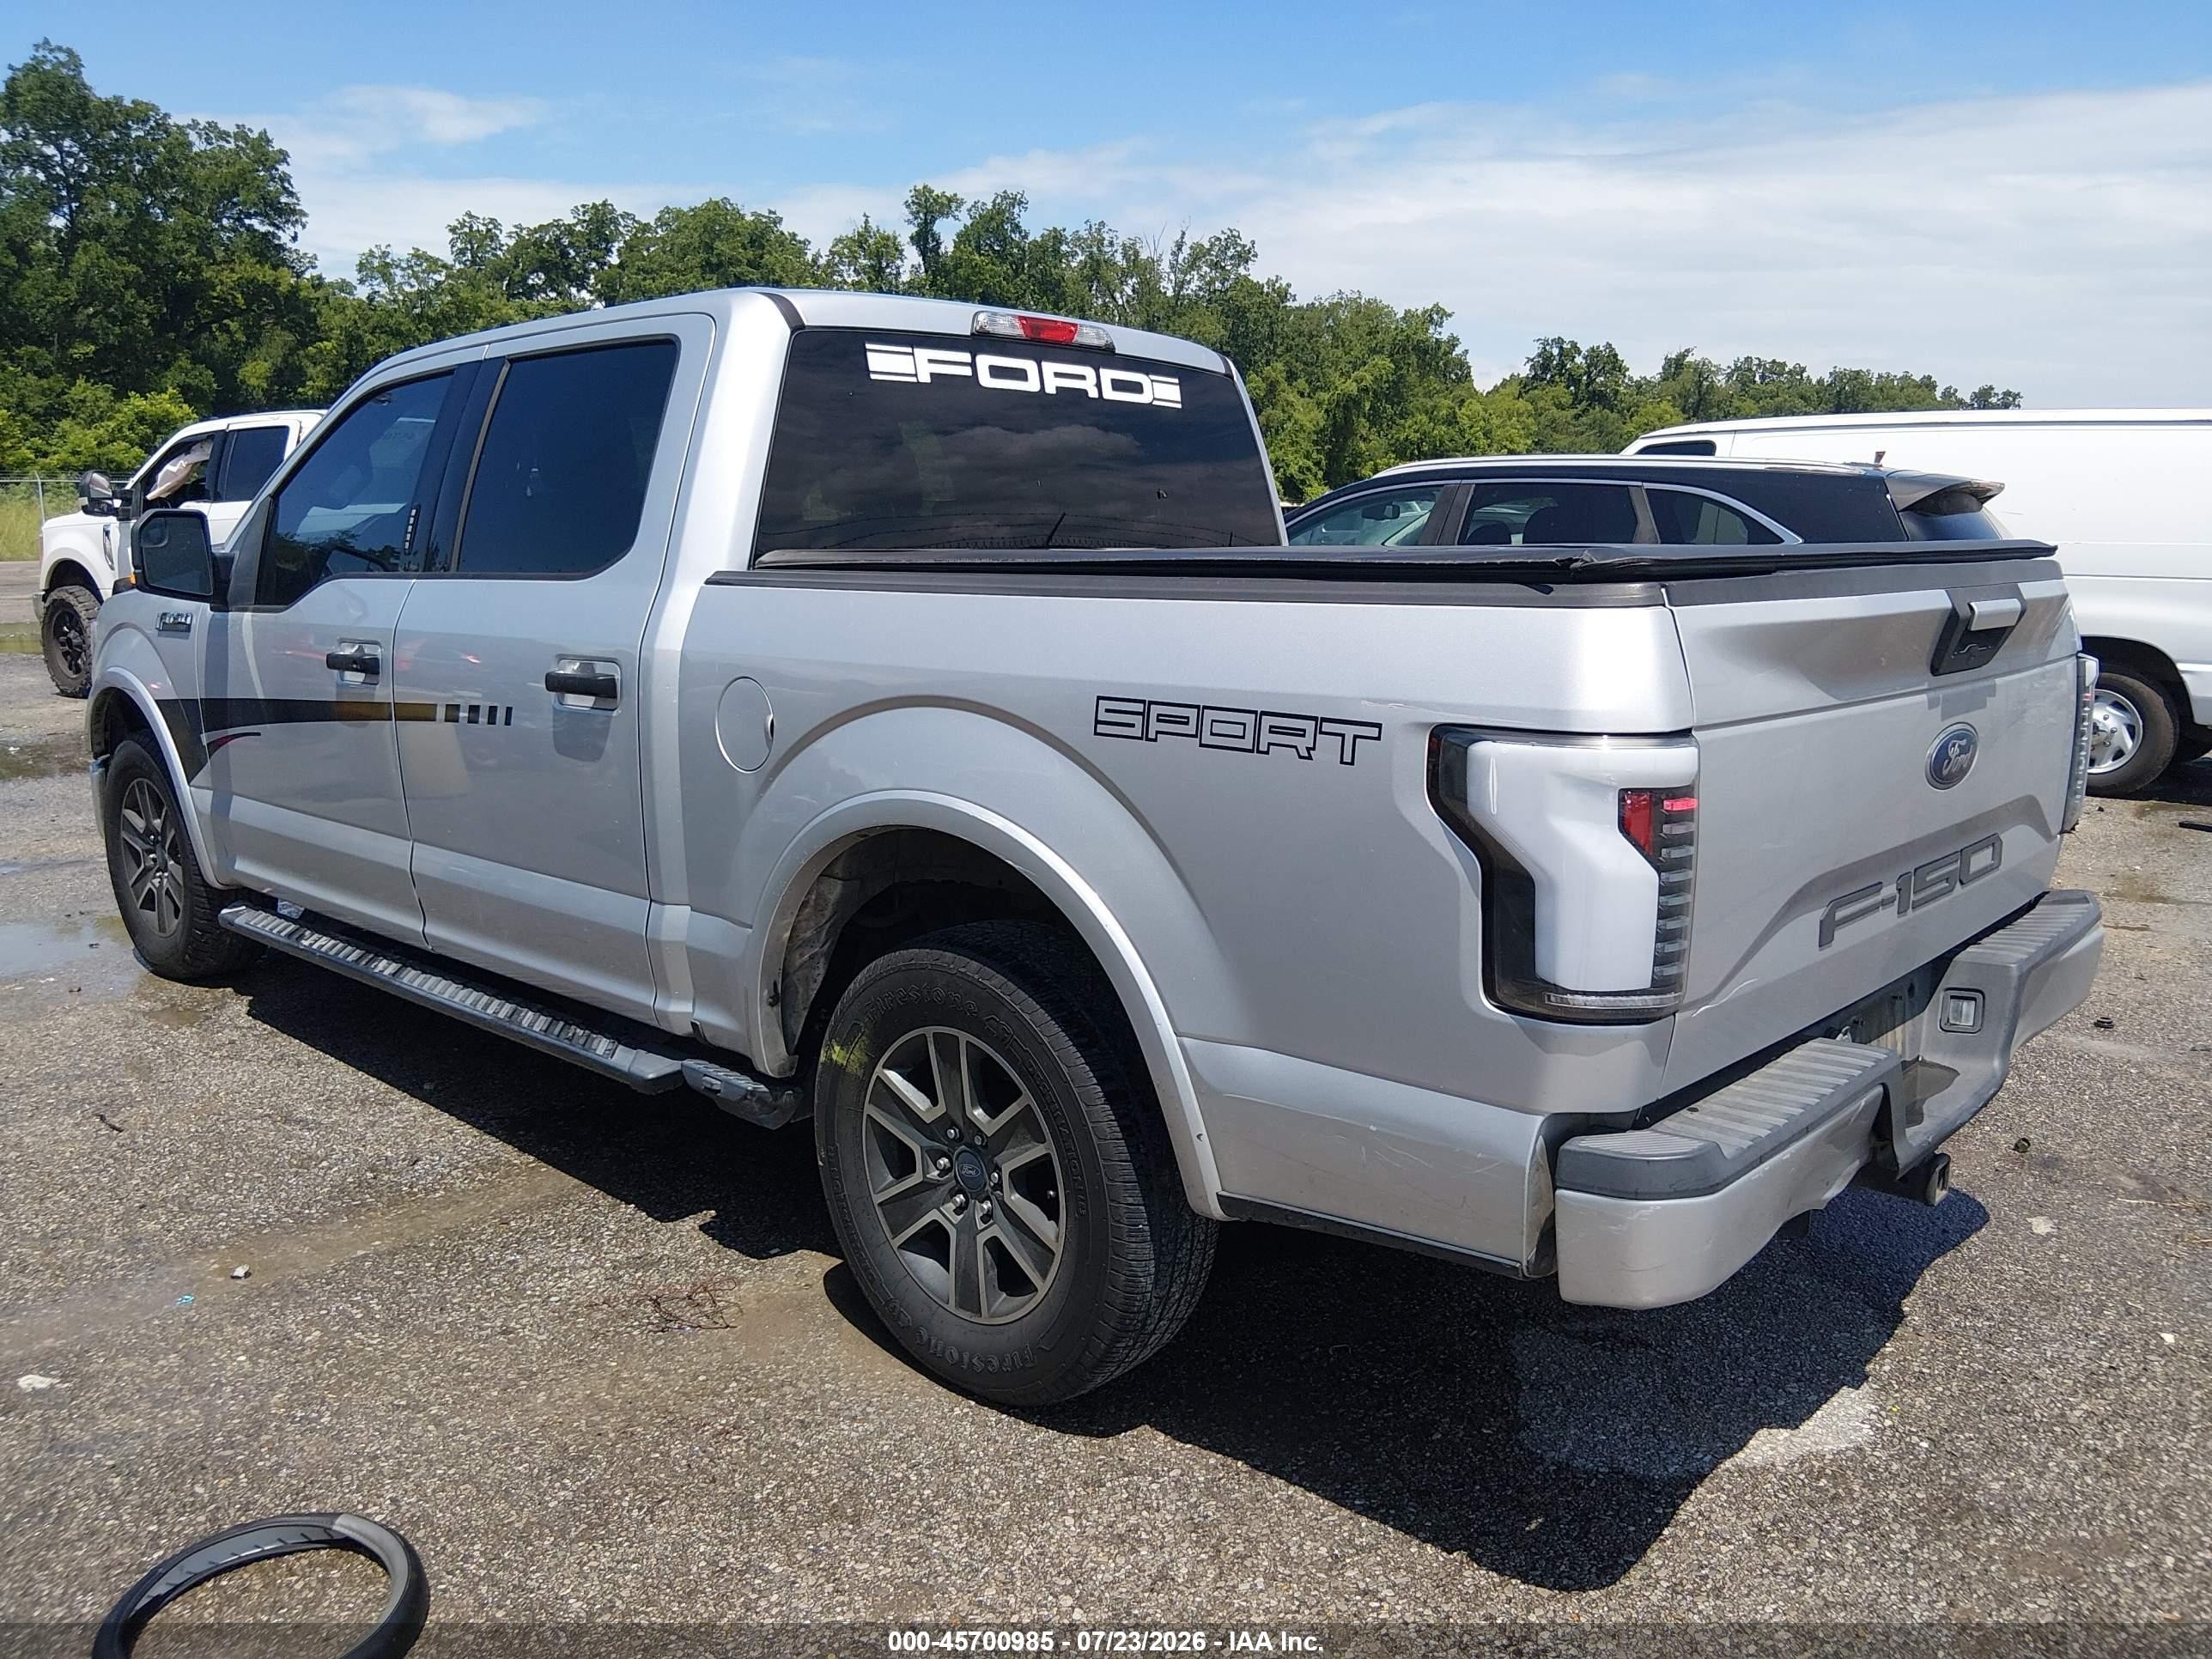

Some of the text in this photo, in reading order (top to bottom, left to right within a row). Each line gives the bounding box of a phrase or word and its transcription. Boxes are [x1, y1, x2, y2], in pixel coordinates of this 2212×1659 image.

[912, 347, 1154, 404] FORD
[1094, 696, 1382, 766] SPORT
[1942, 738, 1975, 775] Ford
[1818, 832, 2003, 949] F-150
